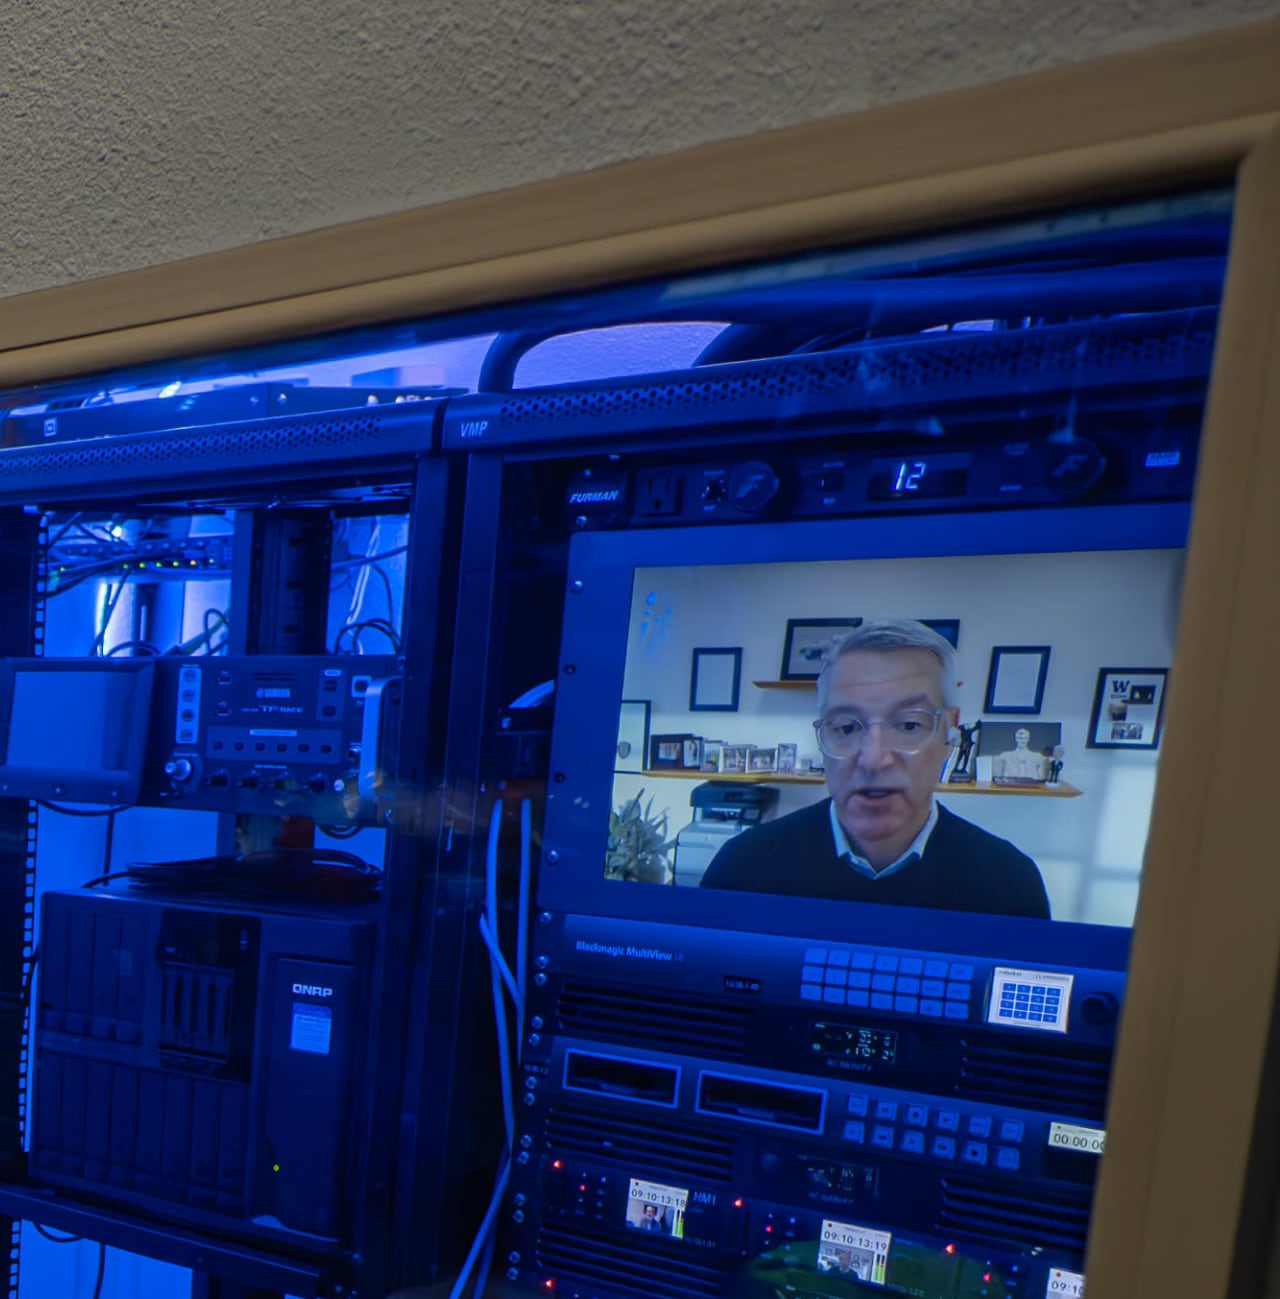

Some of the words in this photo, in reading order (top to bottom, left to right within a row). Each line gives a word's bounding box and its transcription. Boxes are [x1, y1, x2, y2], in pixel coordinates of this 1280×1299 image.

[460, 421, 488, 438] VMP
[894, 461, 927, 491] 12
[569, 490, 620, 503] FURMAN
[1111, 680, 1131, 693] W
[575, 939, 625, 957] Blackmagic
[626, 945, 673, 961] MultiView
[823, 1230, 888, 1252] 09:10:13:19
